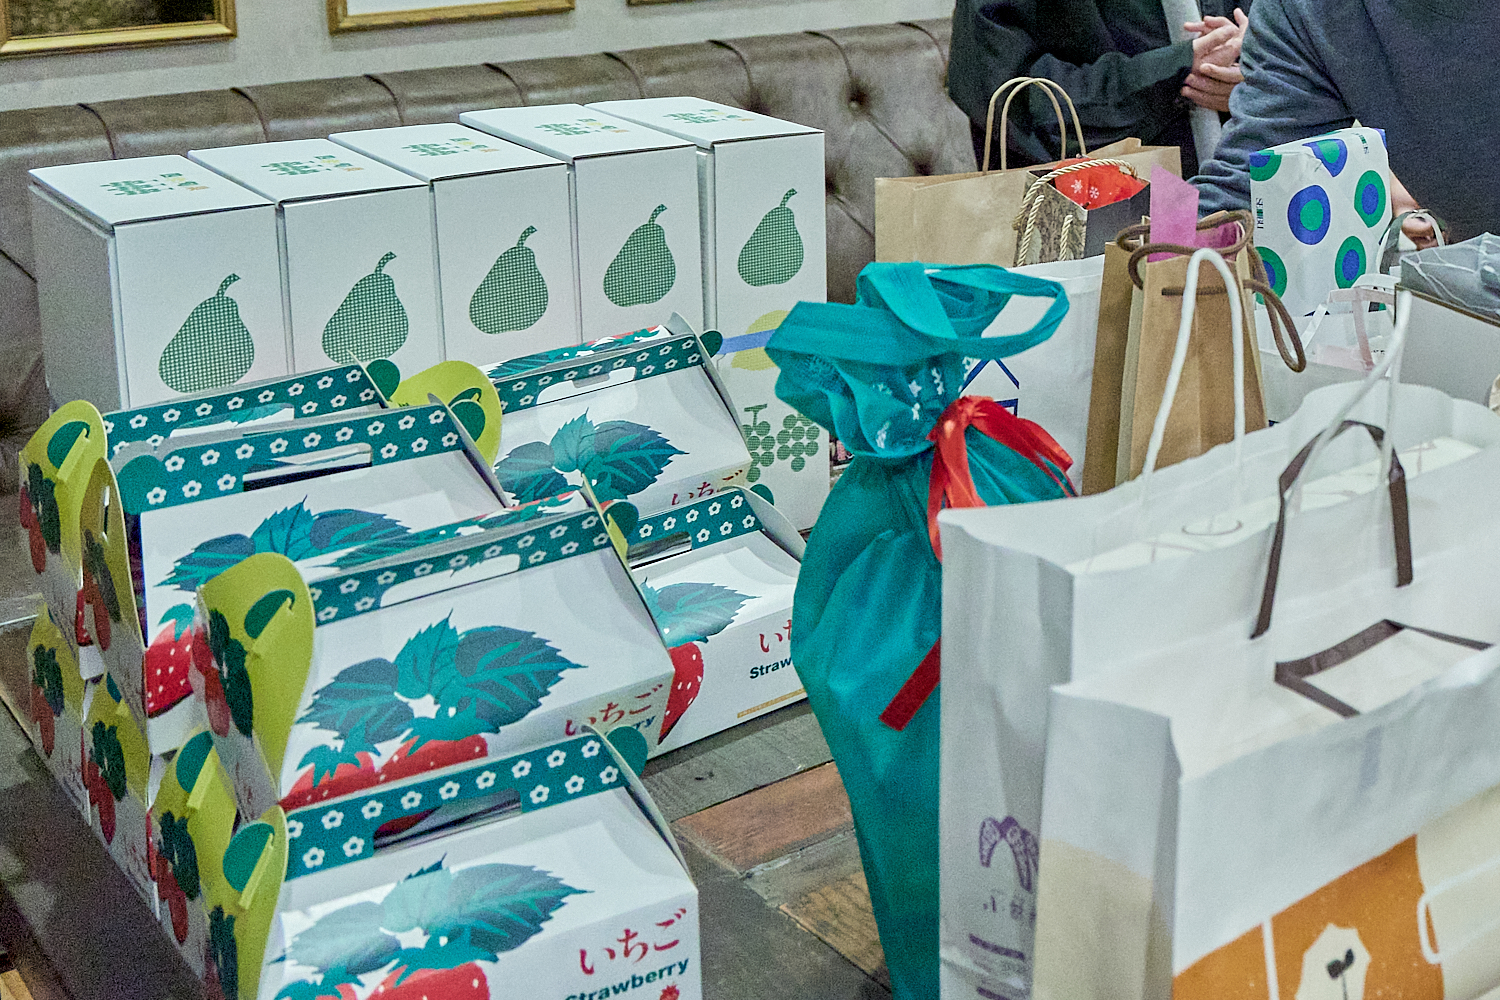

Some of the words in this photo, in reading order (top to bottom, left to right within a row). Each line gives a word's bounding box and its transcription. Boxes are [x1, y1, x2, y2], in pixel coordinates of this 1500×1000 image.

[564, 683, 663, 736] いちご
[579, 908, 687, 975] いちご
